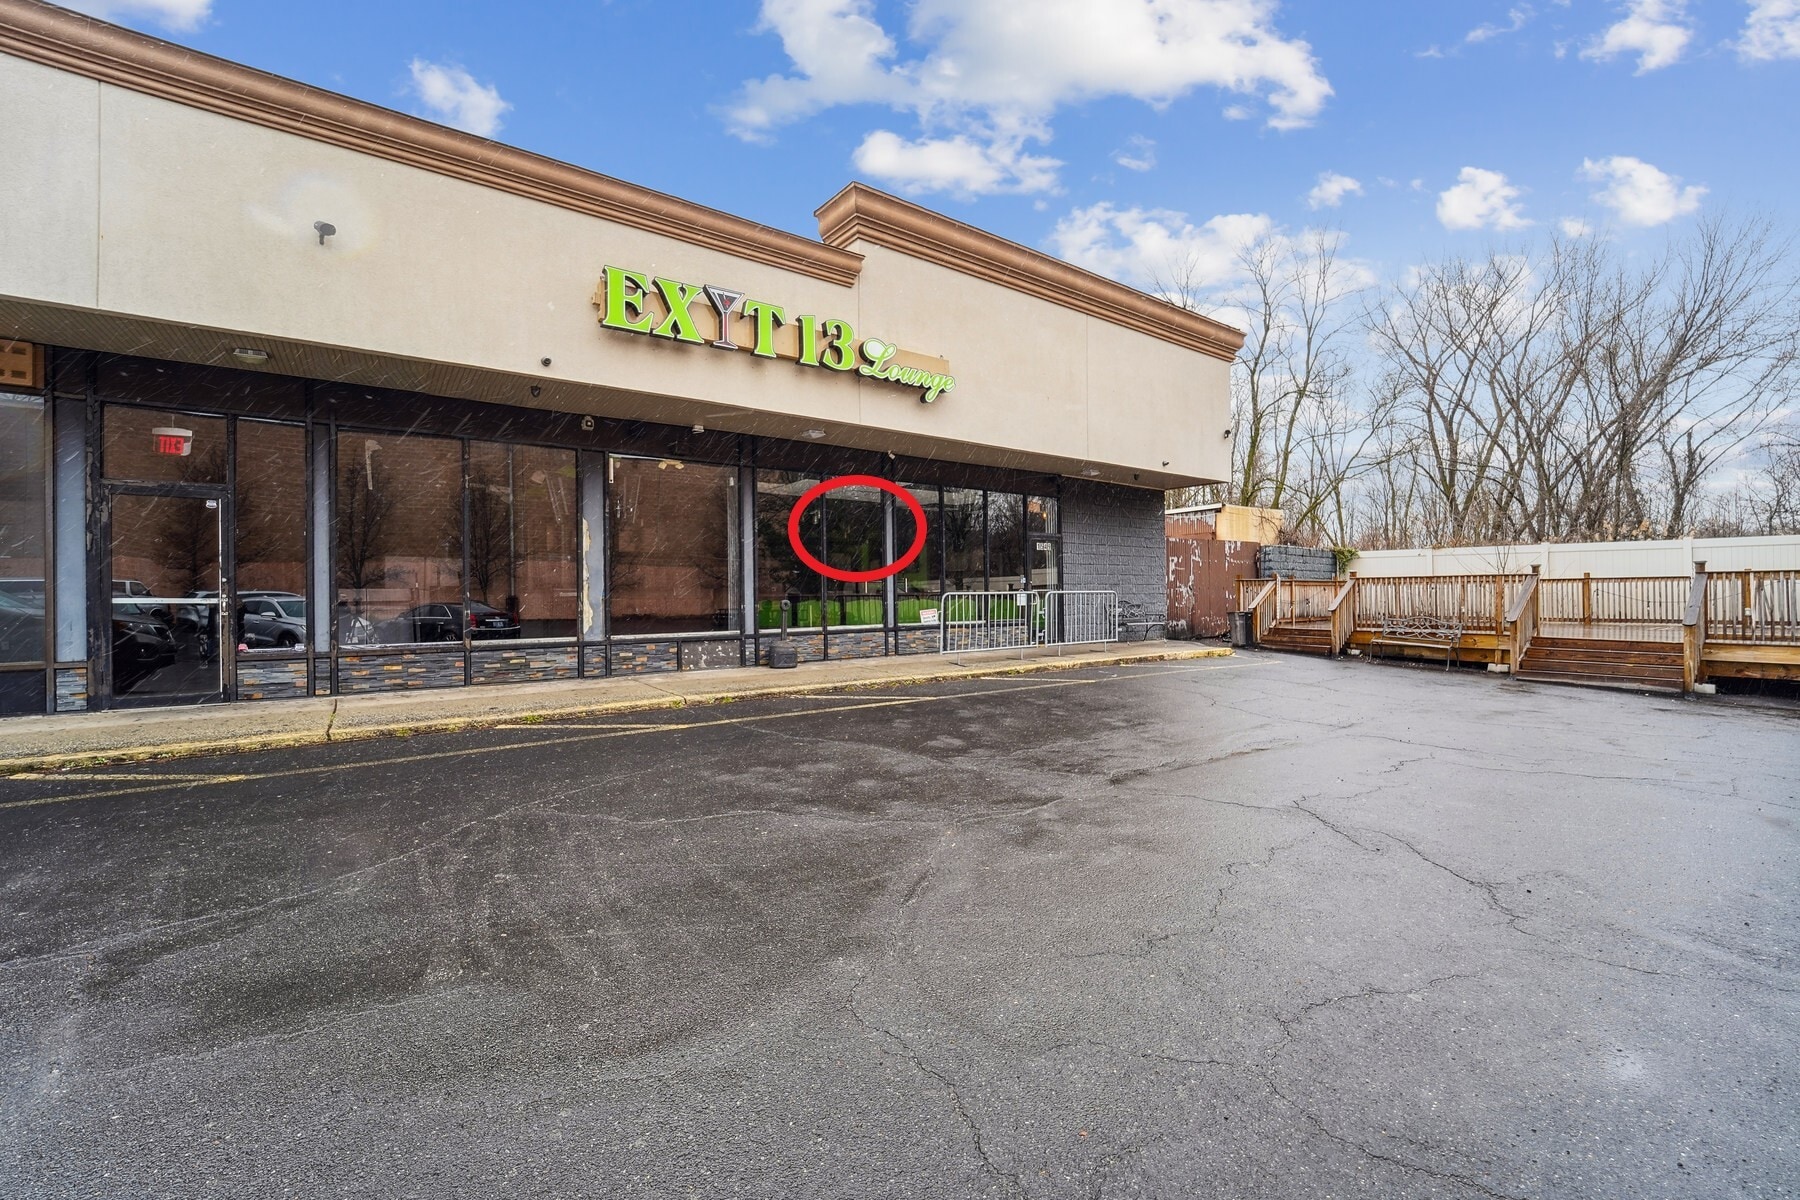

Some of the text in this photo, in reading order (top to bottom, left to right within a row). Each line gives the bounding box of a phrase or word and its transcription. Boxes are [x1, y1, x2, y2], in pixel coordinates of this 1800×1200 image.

[601, 265, 957, 403] EXYT 13 Lounge
